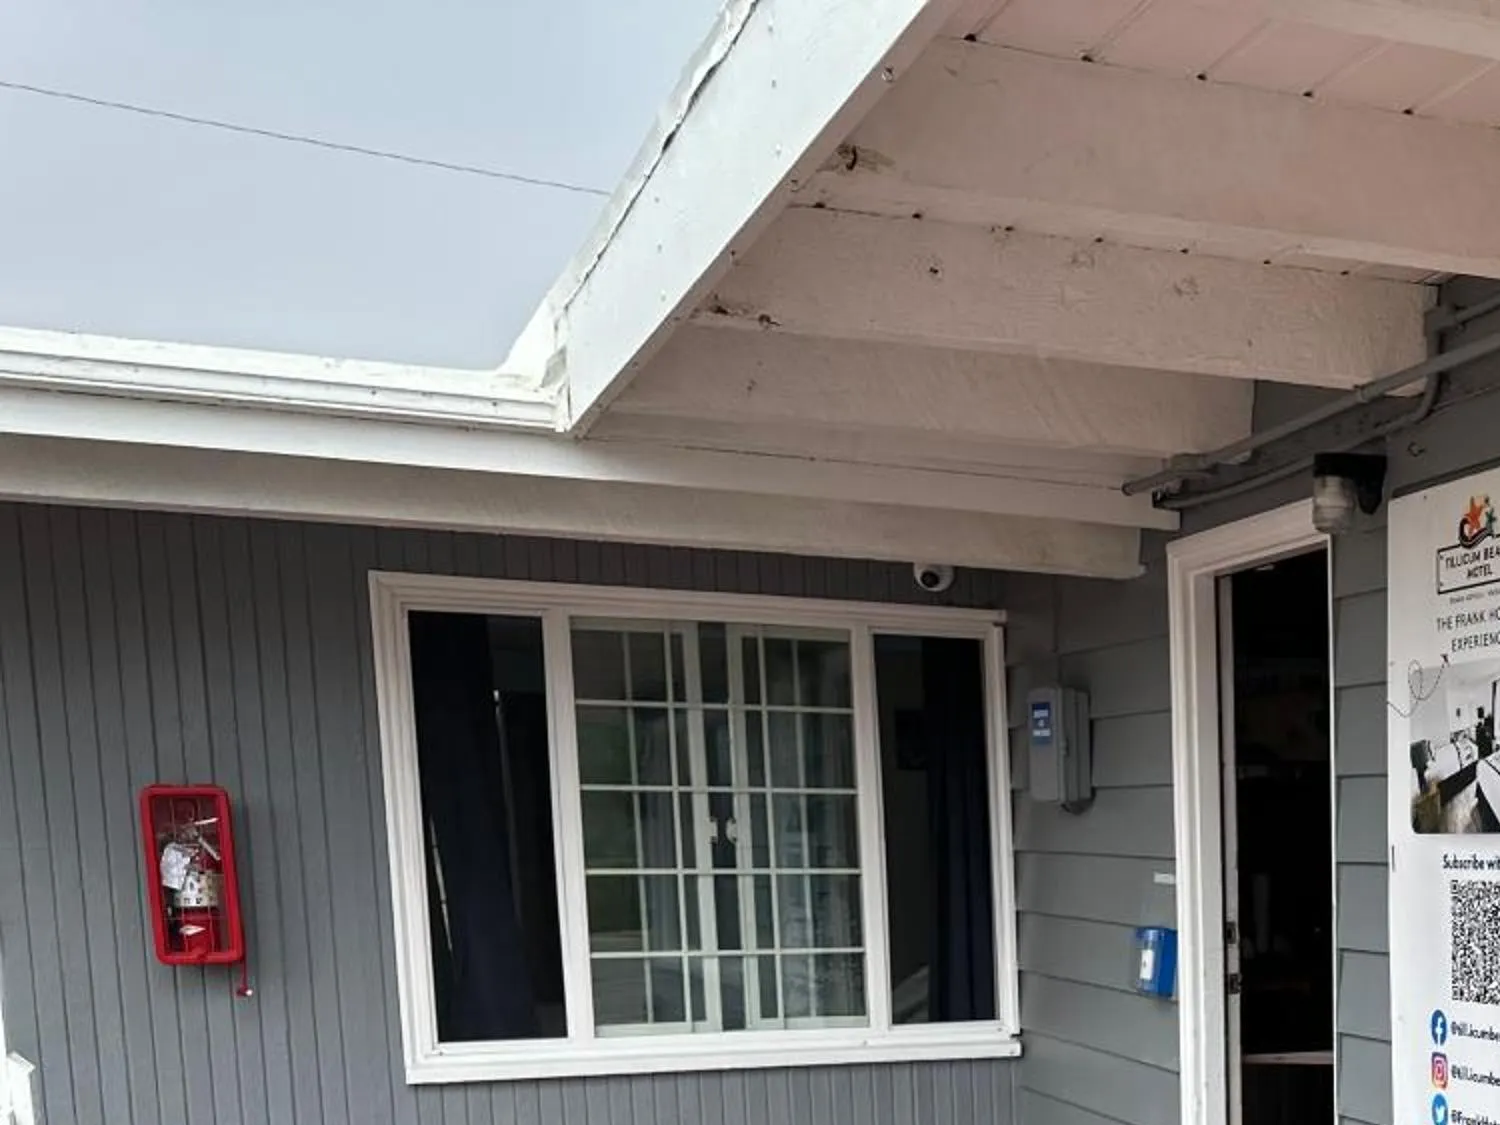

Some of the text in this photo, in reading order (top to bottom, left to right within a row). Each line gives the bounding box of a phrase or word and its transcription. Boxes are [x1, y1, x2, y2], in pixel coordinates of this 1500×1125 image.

[1436, 615, 1452, 632] THE
[1455, 611, 1485, 629] FRANK
[1443, 854, 1485, 870] Subscribe
